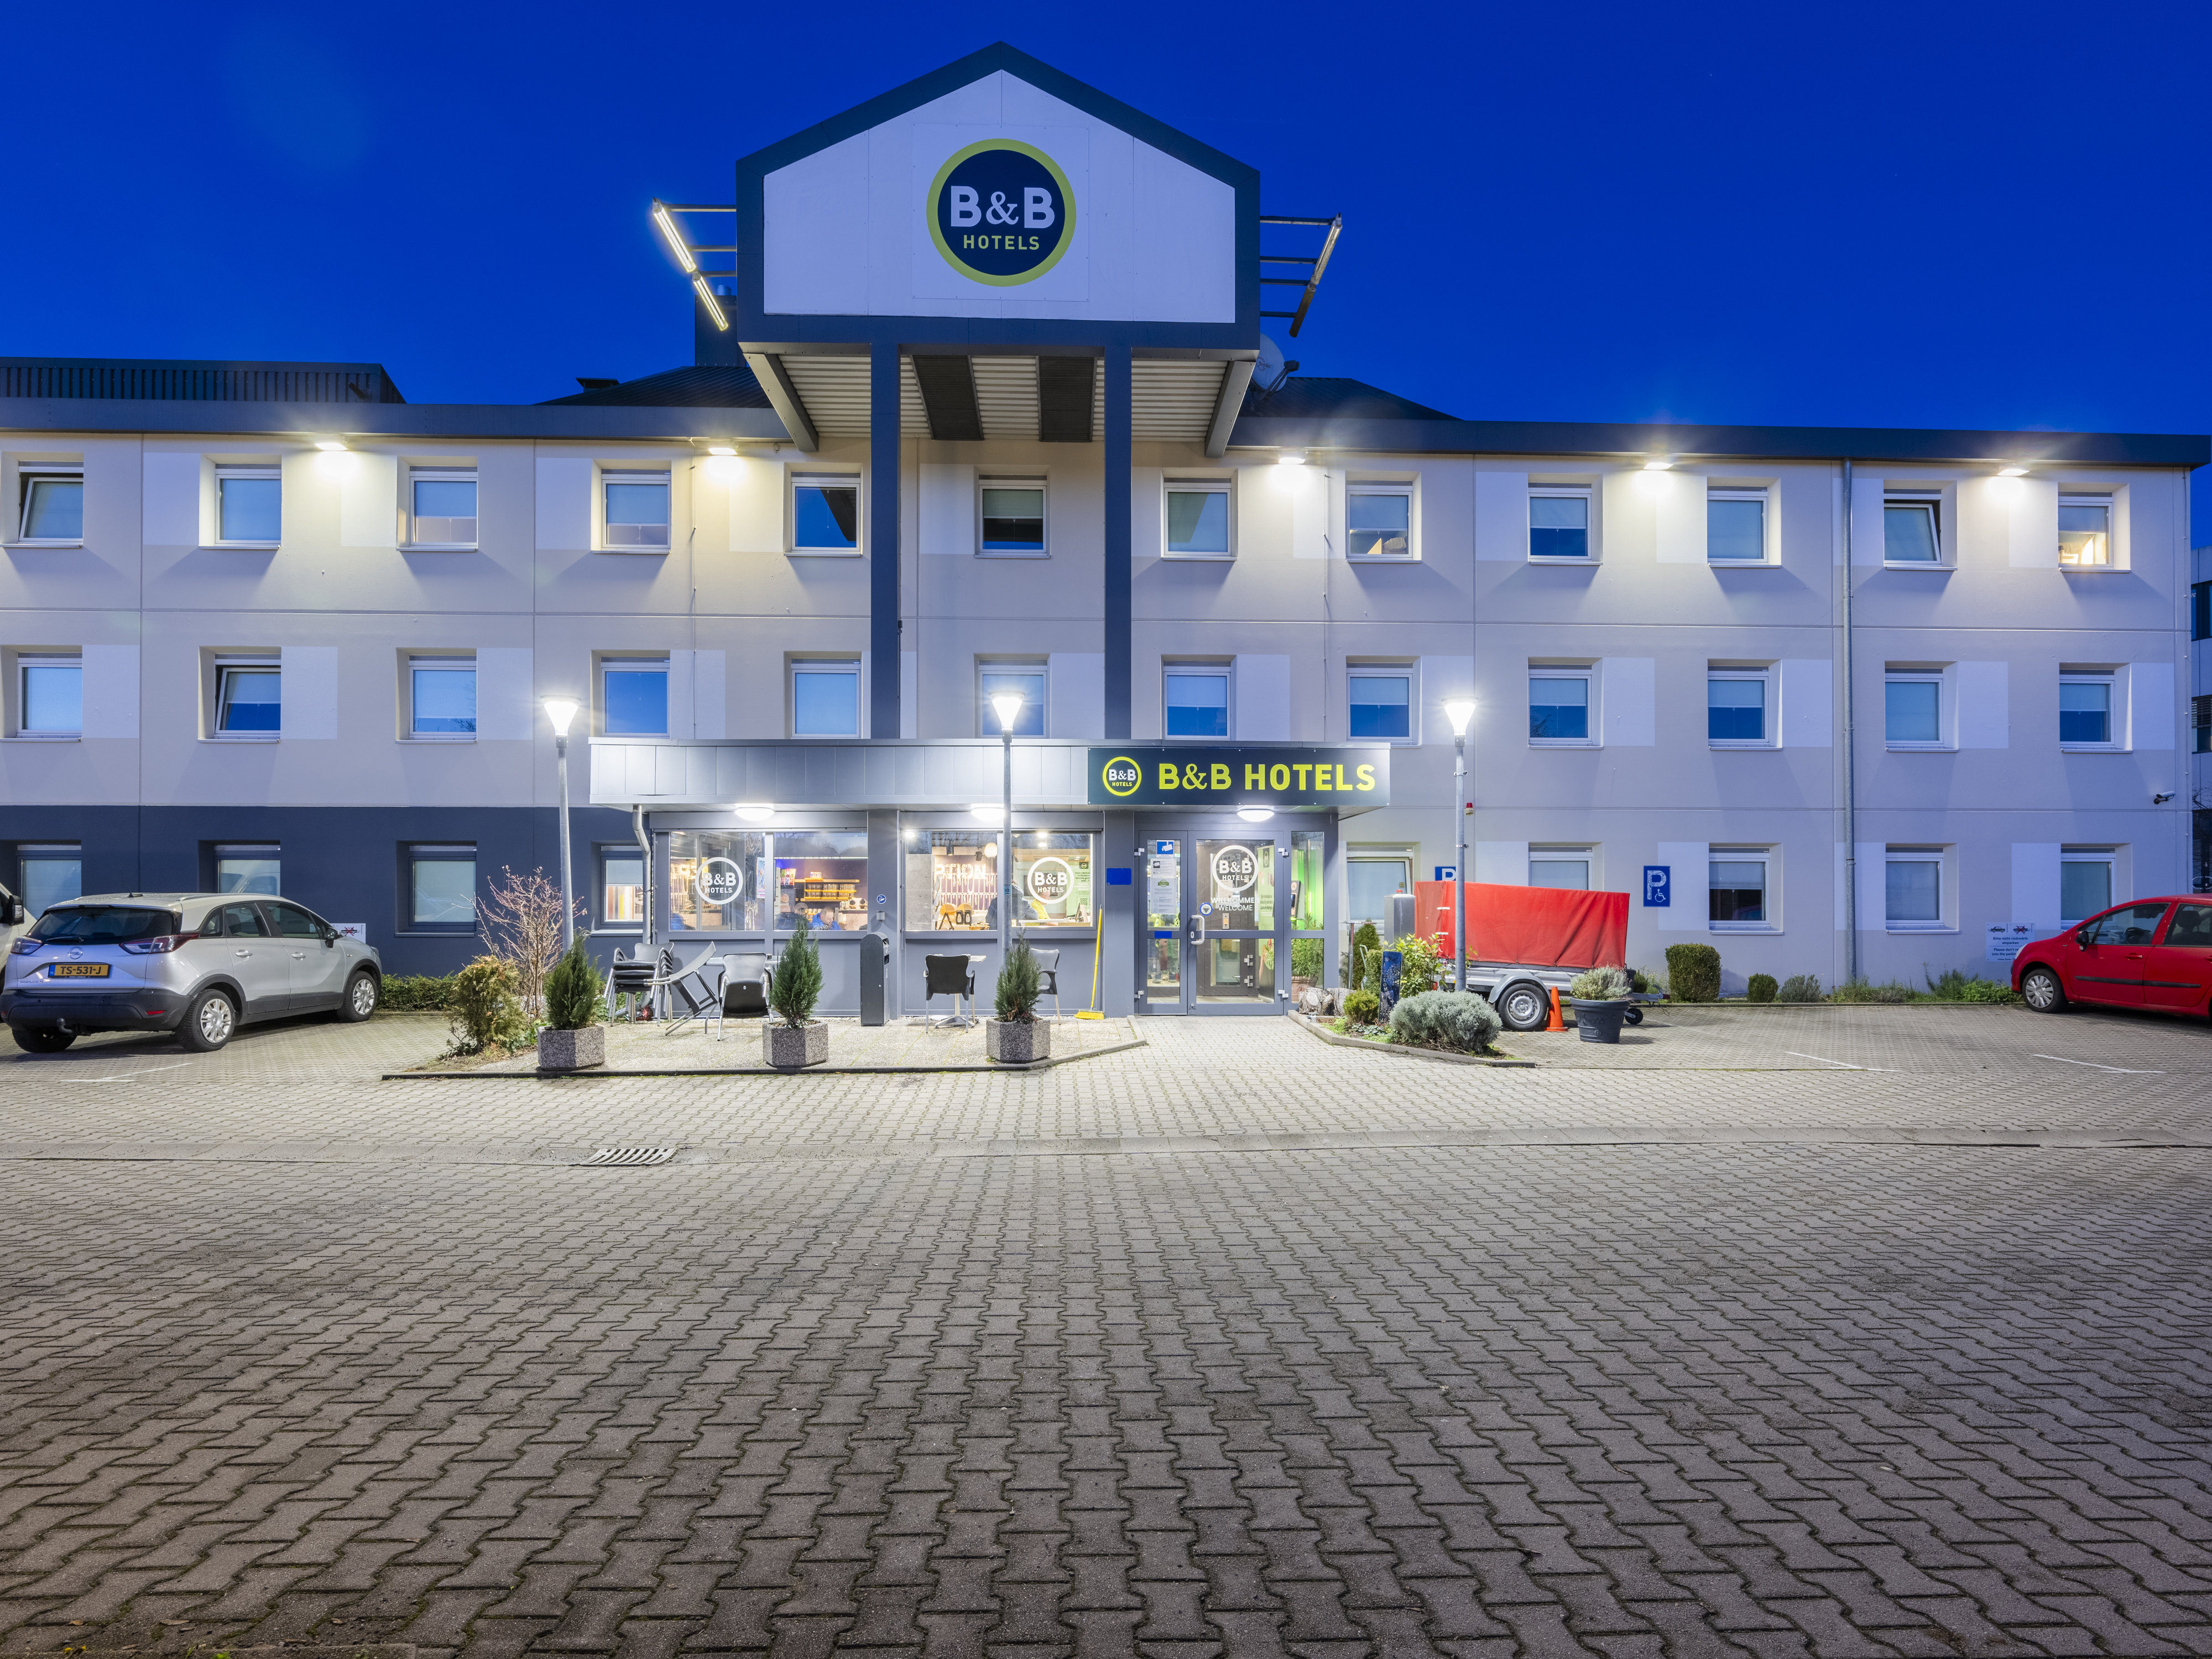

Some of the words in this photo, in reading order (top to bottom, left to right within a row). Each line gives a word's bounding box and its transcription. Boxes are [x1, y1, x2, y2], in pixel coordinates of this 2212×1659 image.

[951, 185, 1055, 229] B&B
[963, 234, 1040, 251] HOTELS
[1109, 769, 1136, 781] B&B
[1159, 763, 1232, 790] B&B
[1245, 764, 1376, 791] HOTELS
[1219, 860, 1252, 874] B&B
[702, 872, 737, 886] B&B
[1035, 872, 1068, 886] B&B
[1647, 870, 1667, 900] P
[60, 966, 102, 974] TS-531-J
